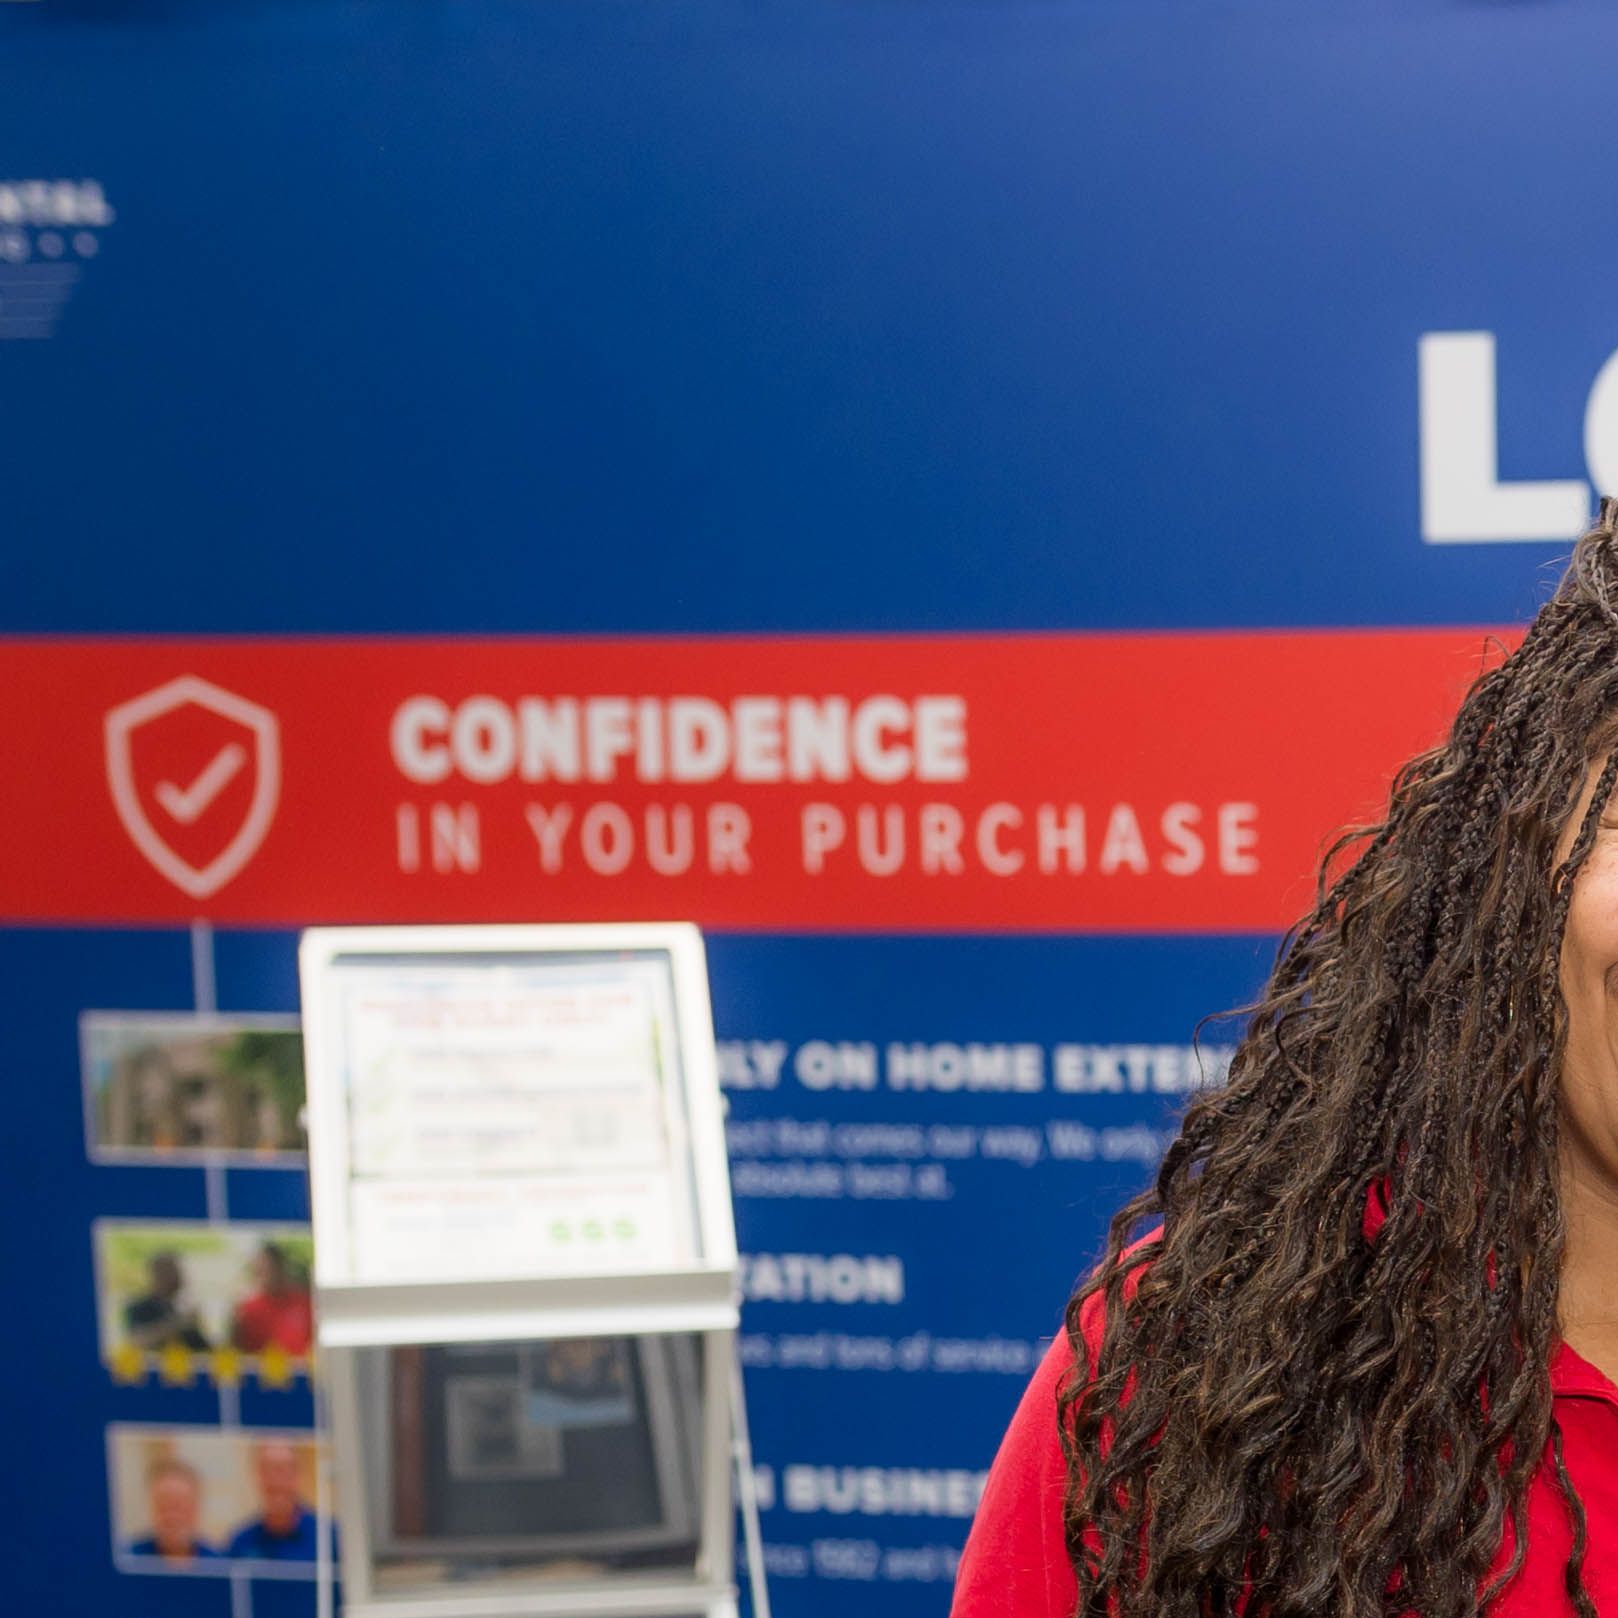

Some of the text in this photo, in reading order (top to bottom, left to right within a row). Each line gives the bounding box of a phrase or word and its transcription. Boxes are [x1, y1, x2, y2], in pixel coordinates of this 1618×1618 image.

[392, 697, 966, 781] CONFIDENCE
[397, 802, 1261, 878] IN YOUR PURCHASE
[795, 1040, 877, 1092] ON
[885, 1041, 1044, 1094] HOME
